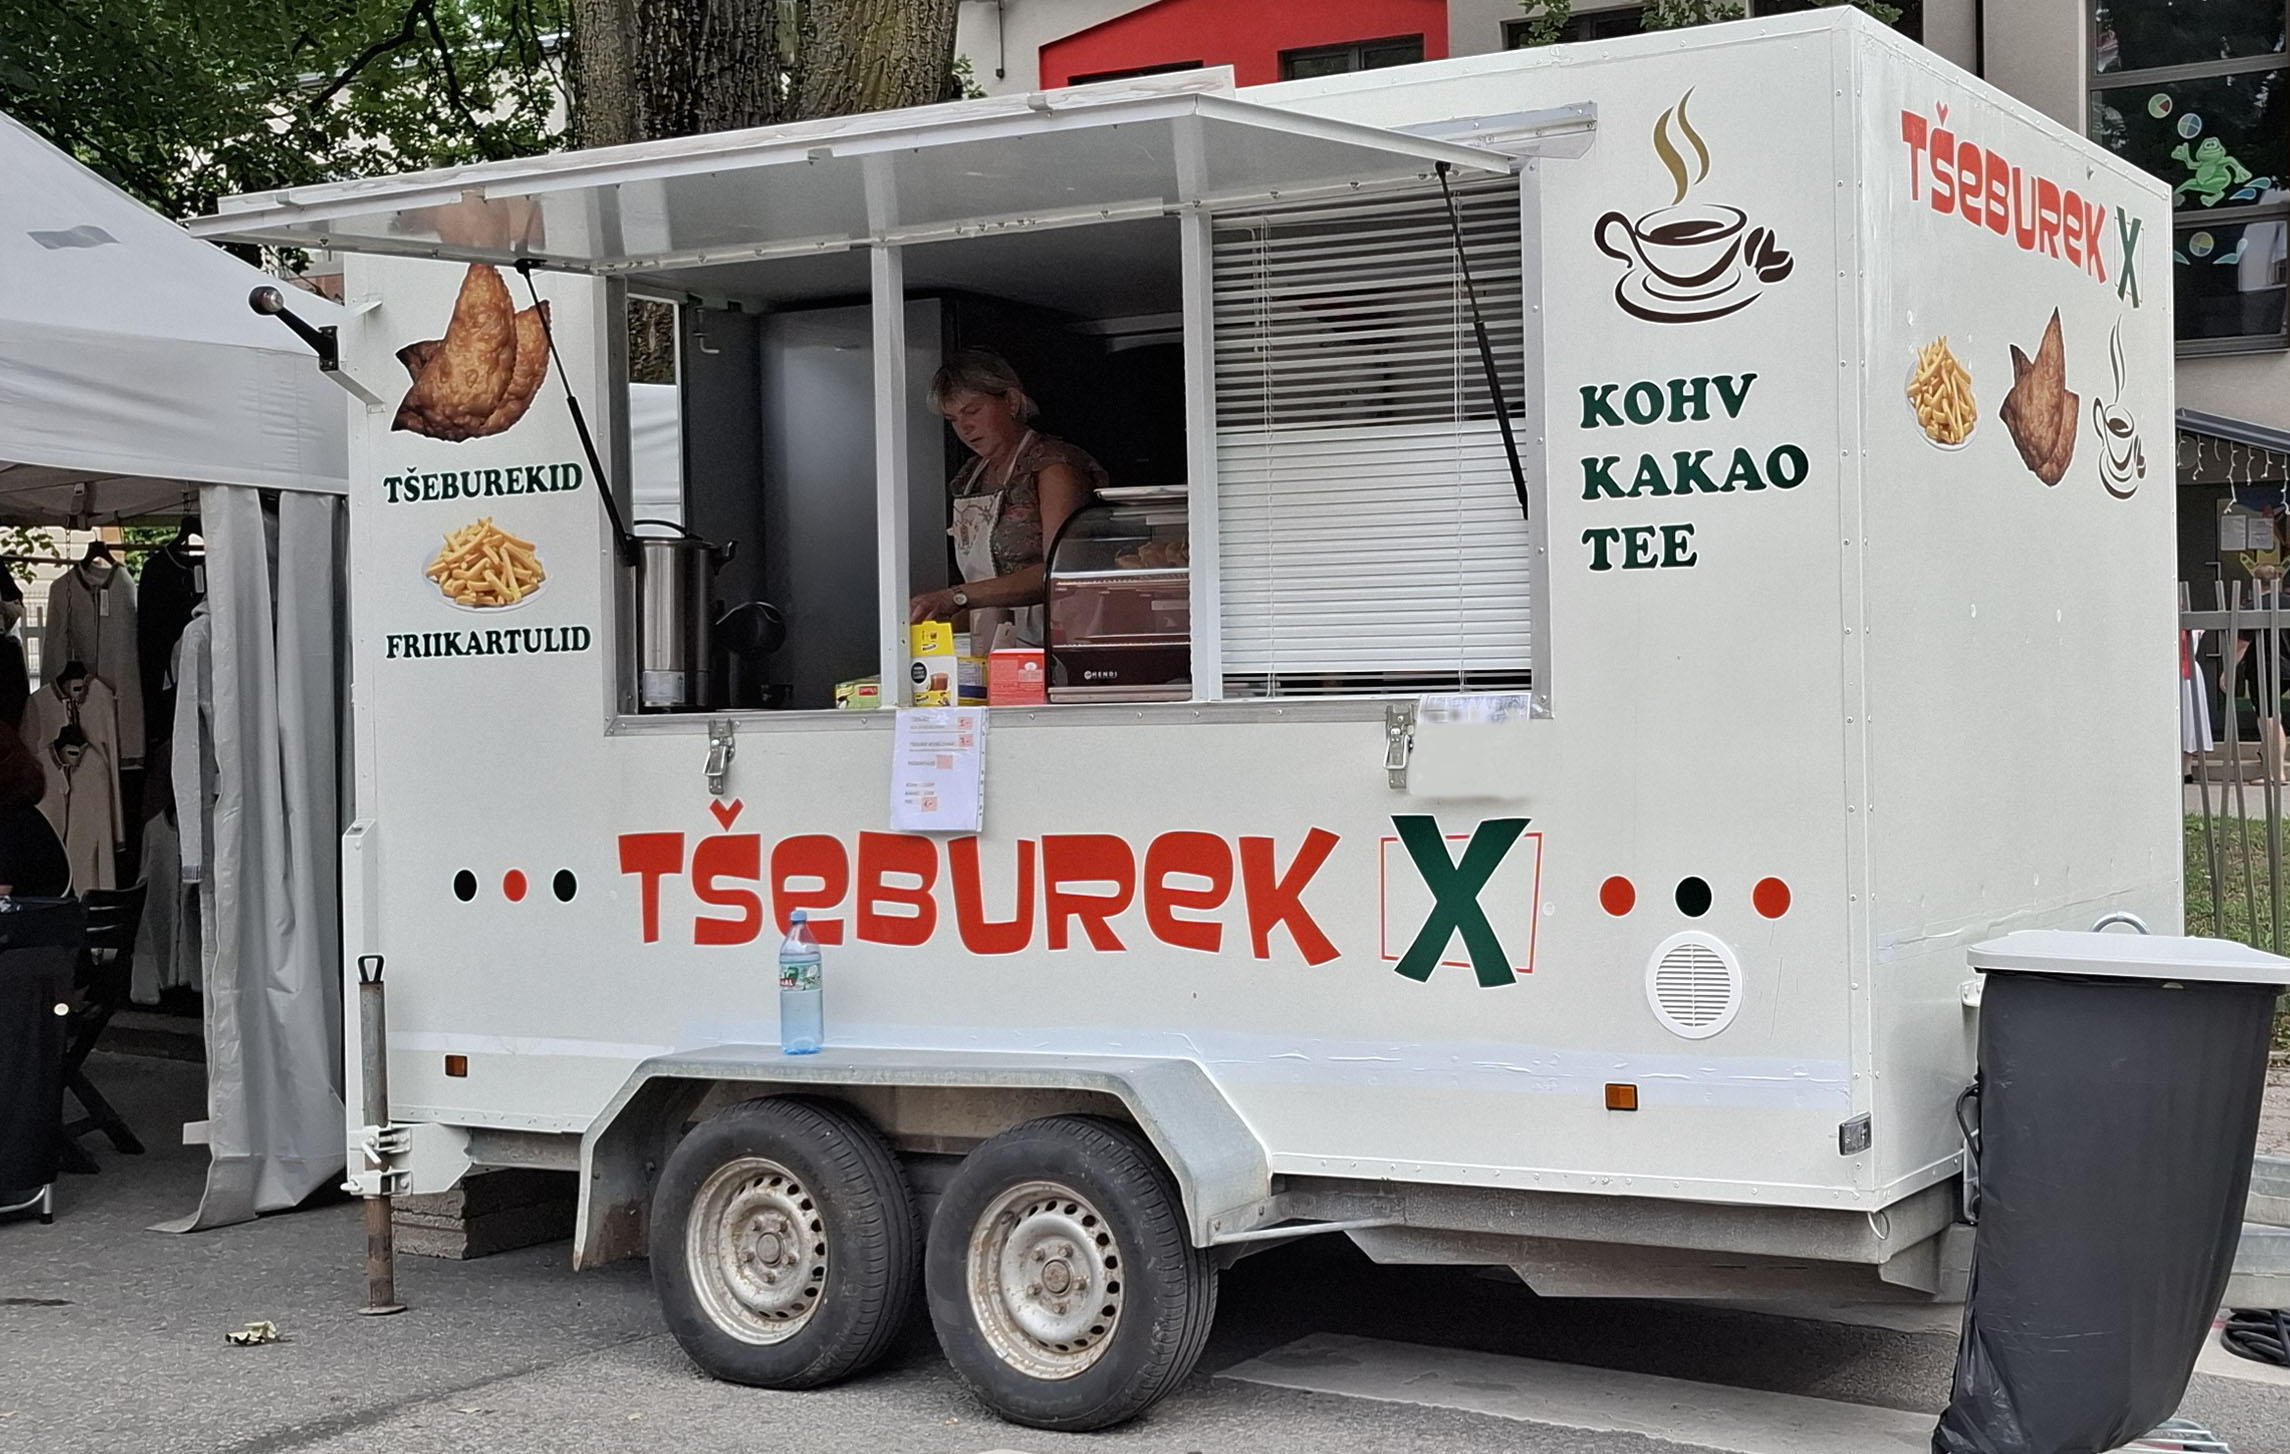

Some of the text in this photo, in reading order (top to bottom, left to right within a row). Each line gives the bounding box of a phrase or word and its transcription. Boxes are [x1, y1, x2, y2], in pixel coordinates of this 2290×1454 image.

[2116, 205, 2142, 308] X
[1580, 374, 1757, 428] KOHV
[384, 463, 582, 502] TŠEBUREKID
[1581, 445, 1808, 499] KAKAO
[1582, 524, 1697, 570] TEE
[387, 627, 590, 658] FRIIKARTULID
[1391, 816, 1531, 987] X
